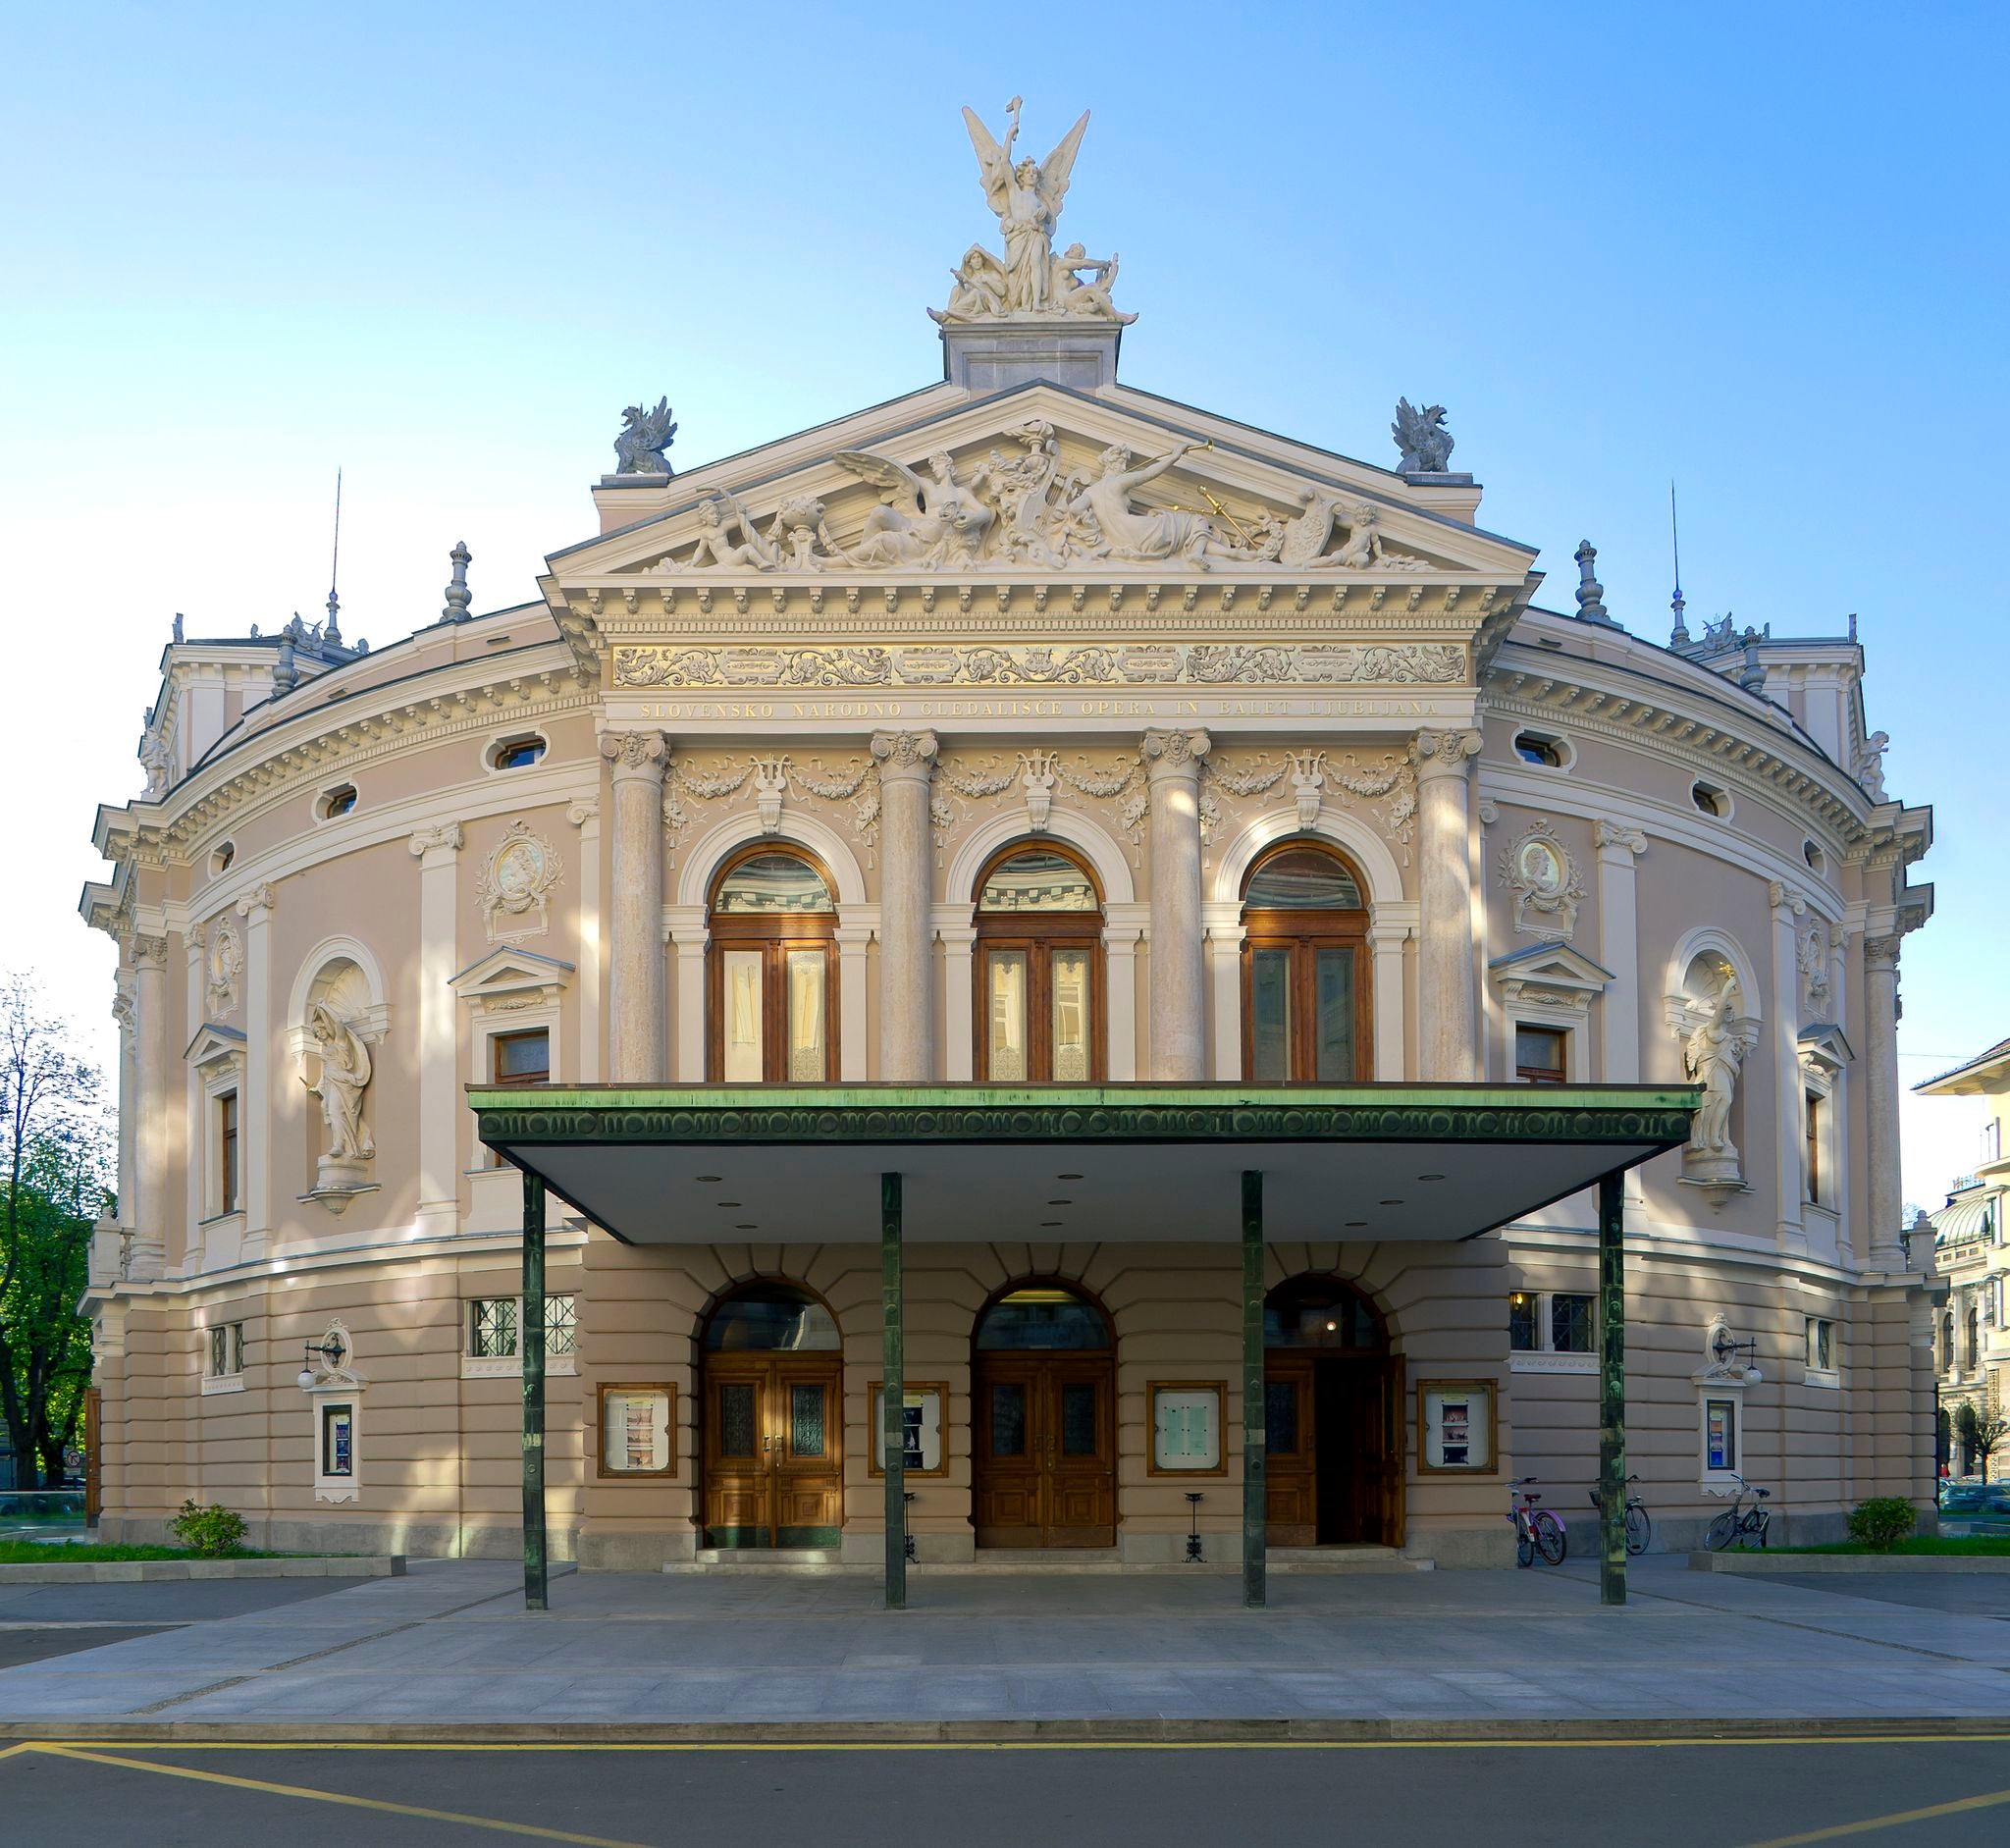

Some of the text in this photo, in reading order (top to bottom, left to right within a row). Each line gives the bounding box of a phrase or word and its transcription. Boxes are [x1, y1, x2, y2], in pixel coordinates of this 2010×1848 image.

[641, 700, 1438, 717] SLOVENSKO NARODNO GLEDALIŠČE OPERA IN BALET LJUBLJANA
